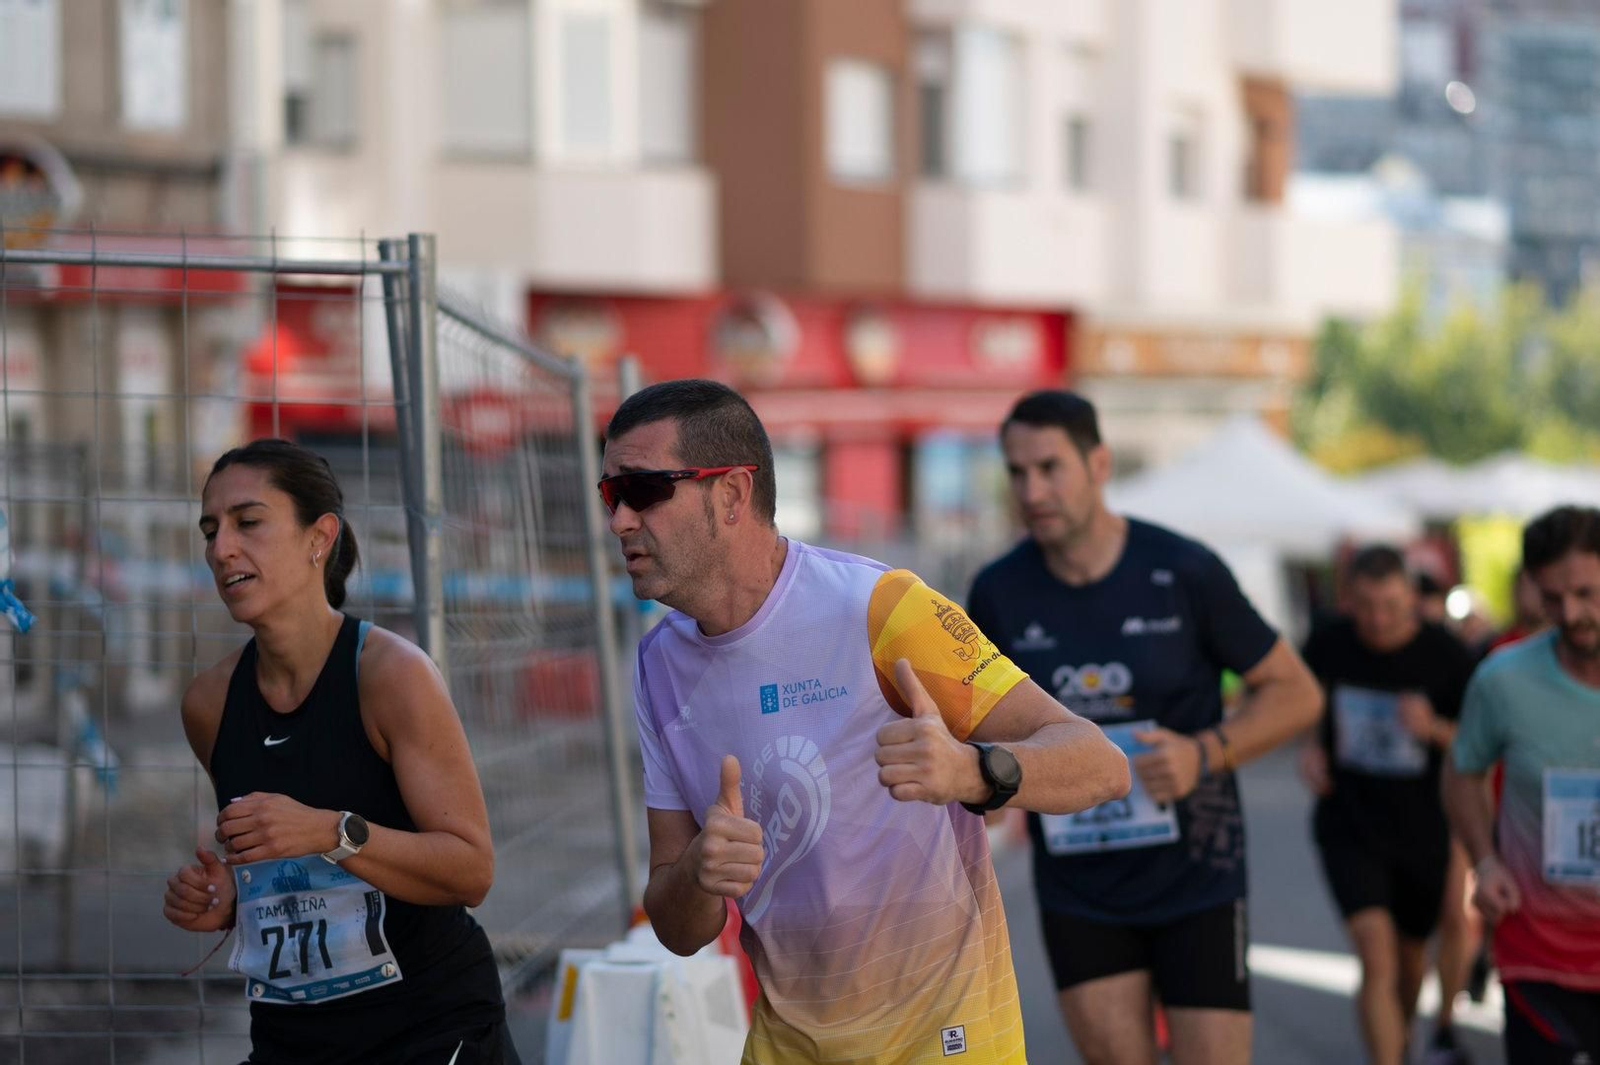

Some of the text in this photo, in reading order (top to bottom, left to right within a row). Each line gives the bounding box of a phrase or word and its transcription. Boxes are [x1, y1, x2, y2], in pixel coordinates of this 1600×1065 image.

[782, 679, 822, 695] XUNTA
[783, 686, 848, 708] DE GALICIA
[256, 897, 327, 920] TAMARIÑA
[260, 918, 333, 981] 271
